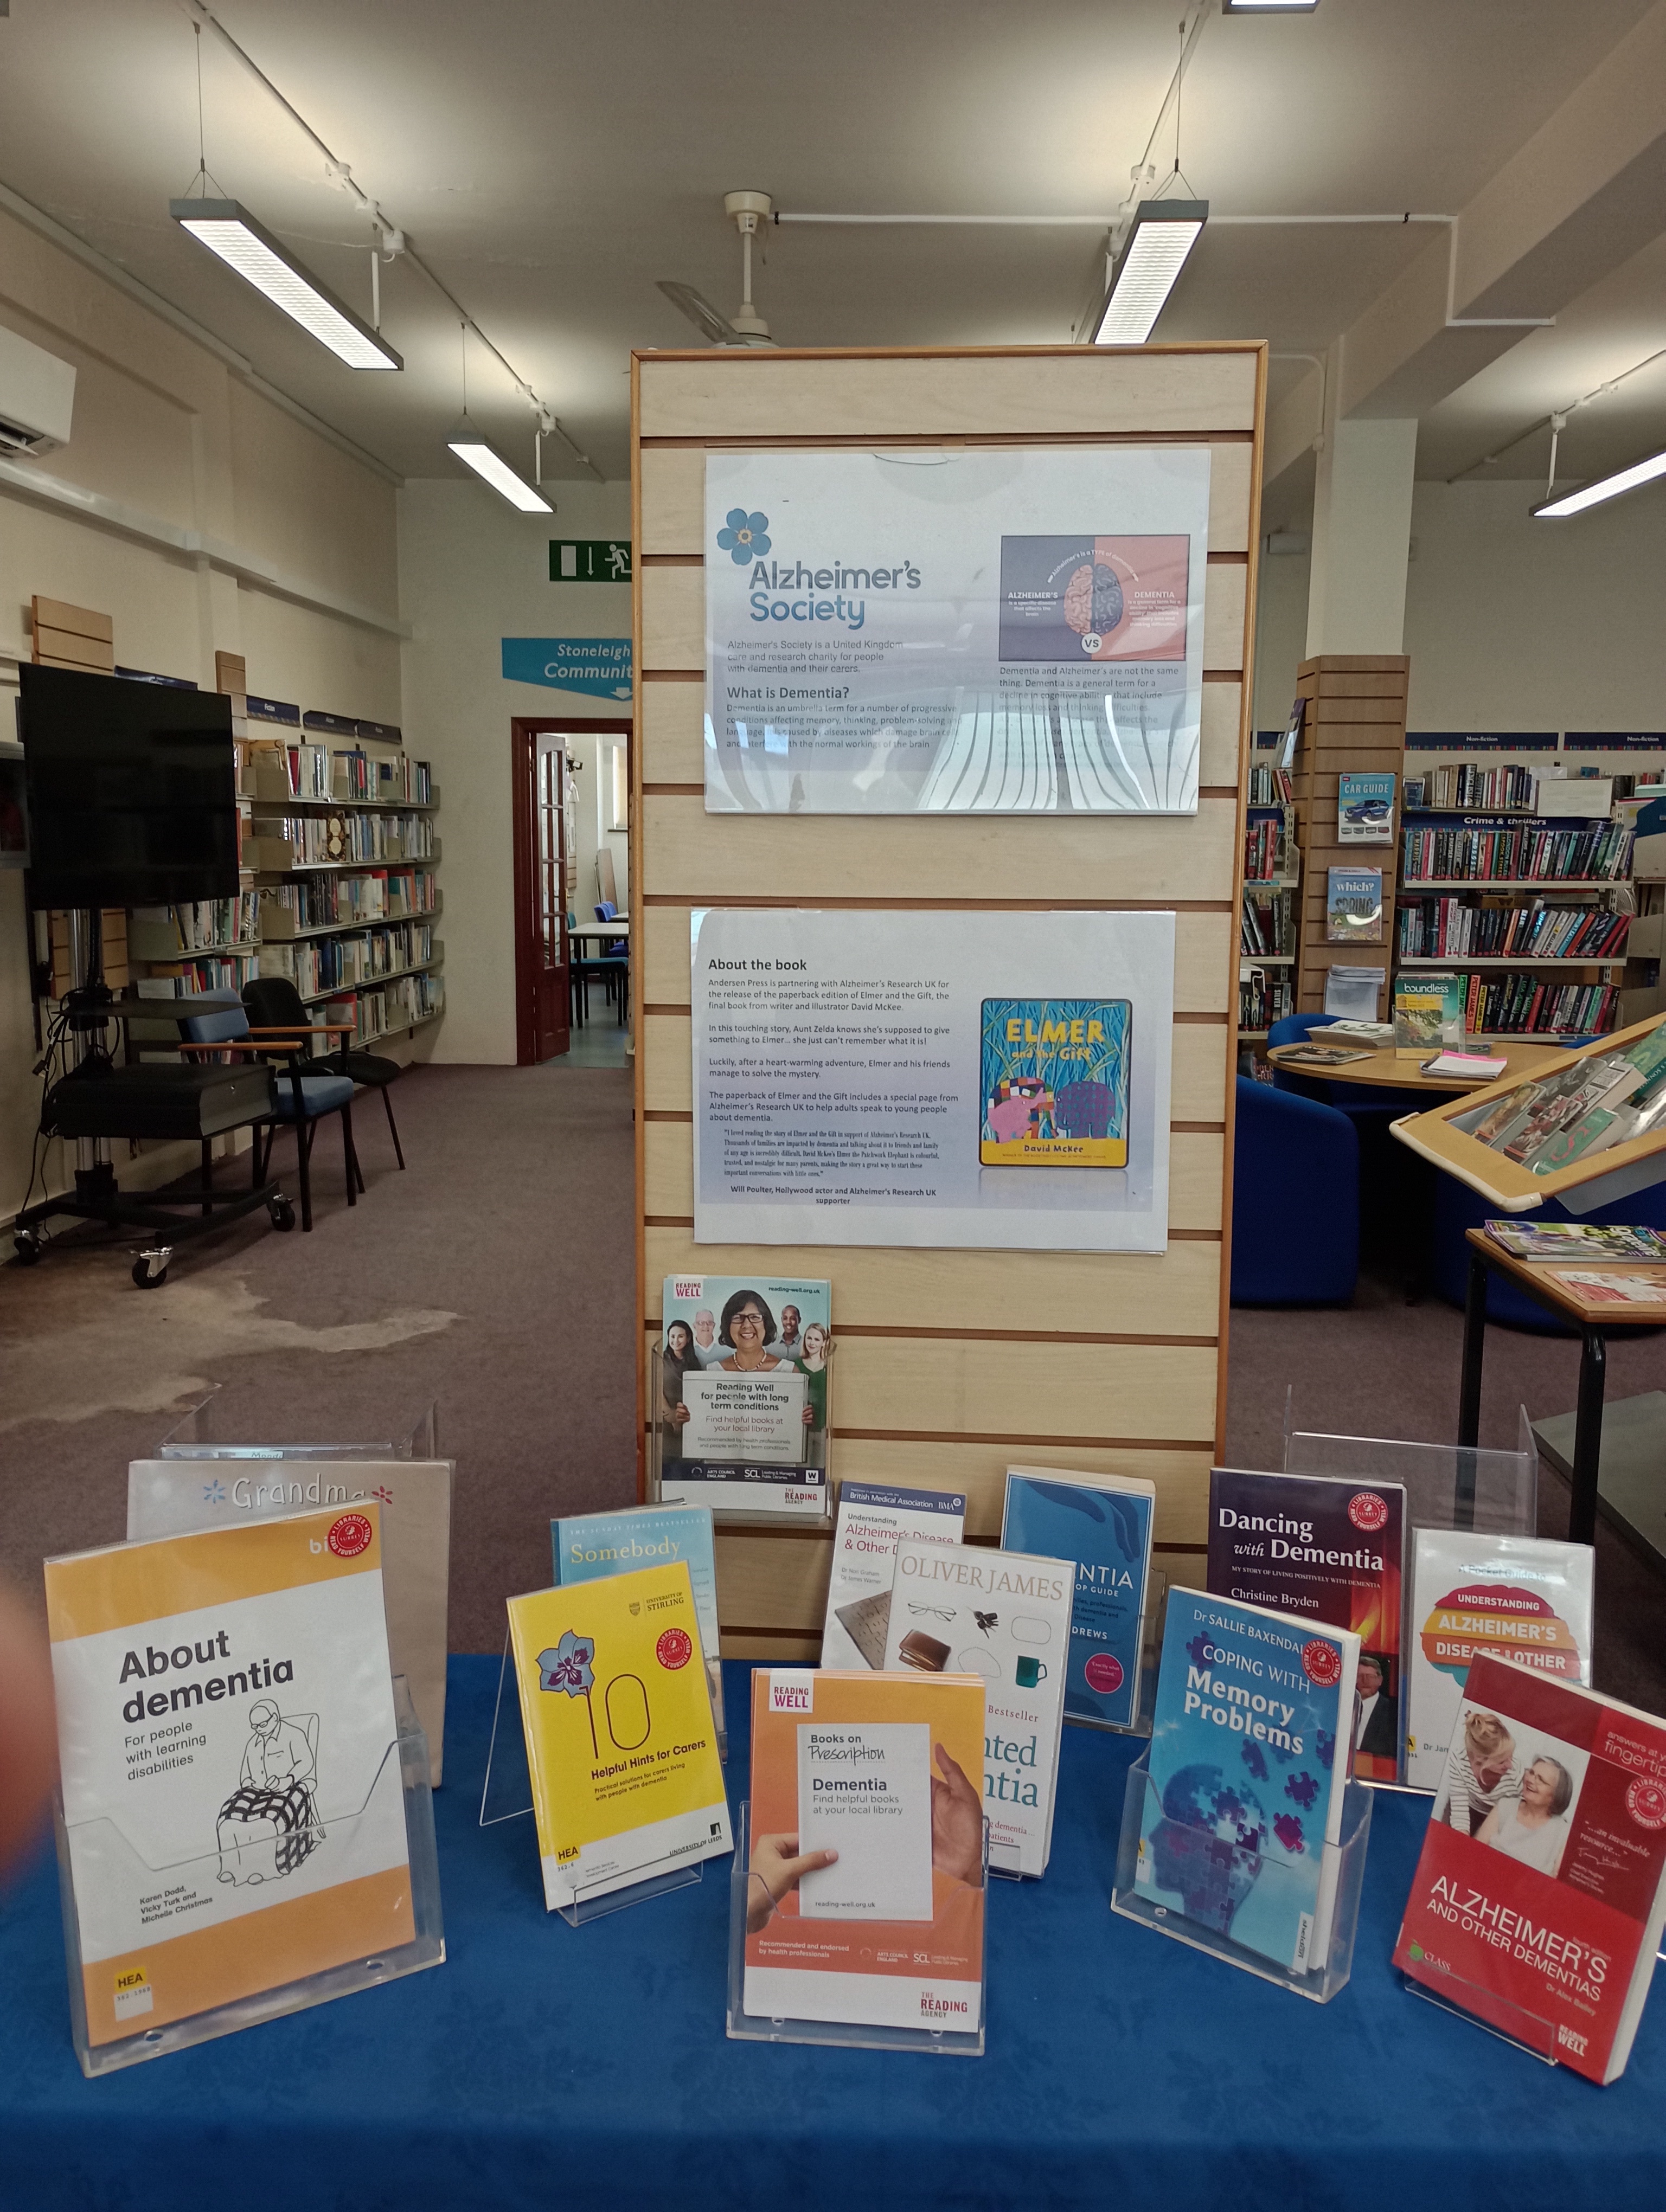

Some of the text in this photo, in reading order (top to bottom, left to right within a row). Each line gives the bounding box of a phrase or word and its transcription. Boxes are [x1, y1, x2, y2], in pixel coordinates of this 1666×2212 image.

[749, 561, 921, 590] Alzheimer's
[750, 592, 865, 630] Society
[728, 640, 778, 649] Alzheimer's
[780, 640, 812, 650] Society
[815, 640, 822, 648] is
[834, 640, 861, 648] United
[864, 640, 903, 651] Kingdom
[1085, 640, 1099, 648] VS
[558, 644, 631, 661] Stoneleigh
[749, 652, 766, 661] and
[768, 652, 806, 661] research
[809, 652, 837, 663] charity
[840, 652, 851, 661] for
[854, 654, 883, 662] people
[544, 663, 632, 678] Communit
[727, 687, 849, 698] What is Dementia?
[1345, 784, 1388, 794] CAR GUIDE
[1336, 882, 1375, 892] which?
[708, 959, 807, 971] About the book
[1404, 983, 1449, 993] boundless
[1007, 1019, 1105, 1044] ELMER
[1011, 1047, 1091, 1060] and the Gift
[1024, 1144, 1050, 1153] David
[676, 1289, 701, 1297] WELL
[716, 1383, 774, 1392] Reading Well
[716, 1393, 746, 1402] people
[770, 1394, 789, 1403] long
[734, 1403, 779, 1411] conditions
[724, 1416, 749, 1425] helpful
[752, 1425, 775, 1434] library
[744, 1469, 760, 1478] SCL
[785, 1491, 817, 1501] READING
[850, 1492, 870, 1501] British
[871, 1494, 896, 1504] Medical
[898, 1497, 933, 1509] Association
[334, 1516, 366, 1530] LIBRARIES
[848, 1513, 897, 1526] Understanding
[1219, 1508, 1313, 1543] Dancing
[337, 1542, 364, 1556] YOURSELF
[571, 1536, 680, 1563] Somebody
[856, 1540, 890, 1554] Other
[1234, 1539, 1384, 1571] with Dementia
[901, 1556, 1063, 1600] OLIVER JAMES
[1091, 1586, 1119, 1598] GUIDE
[1231, 1588, 1319, 1608] Christine Bryden
[647, 1597, 684, 1612] STIRLING
[1458, 1594, 1540, 1611] UNDERSTANDING
[1209, 1615, 1245, 1635] SALLIE
[1439, 1615, 1556, 1641] ALZHEIMER'S
[119, 1630, 231, 1683] About
[1308, 1641, 1337, 1657] LIBRARIES
[1514, 1651, 1565, 1669] OTHER
[1202, 1645, 1310, 1694] COPING WITH
[123, 1659, 294, 1723] dementia
[774, 1687, 809, 1695] READING
[1187, 1666, 1295, 1727] Memory
[774, 1695, 809, 1708] WELL
[579, 1673, 651, 1759] 10
[988, 1705, 1039, 1722] Bestseller
[1184, 1691, 1303, 1754] Problems
[125, 1721, 193, 1748] For people
[811, 1734, 844, 1743] Books
[1607, 1732, 1646, 1752] answers
[126, 1733, 207, 1764] with learning
[808, 1745, 885, 1766] Prescription
[127, 1754, 194, 1780] disabilities
[591, 1740, 706, 1780] Helpful Hints for Carers
[608, 1775, 667, 1799] people with dementia
[813, 1778, 887, 1791] Dementia
[813, 1795, 833, 1803] Find
[836, 1795, 868, 1805] helpful
[825, 1808, 846, 1816] your
[849, 1806, 871, 1814] local
[873, 1806, 903, 1816] library
[708, 1835, 722, 1843] LEEDS
[558, 1847, 578, 1860] HEA
[139, 1886, 187, 1904] Karen Dodd,
[140, 1892, 196, 1915] Vicky Turk and
[142, 1897, 213, 1924] Michelle Christmas
[1431, 1875, 1607, 1983] ALZHEIMER'S
[759, 1940, 806, 1949] Recommended
[1426, 1899, 1458, 1923] AND
[1461, 1917, 1511, 1952] OTHER
[1514, 1944, 1601, 2001] DEMENTIAS
[789, 1950, 830, 1958] professionals
[913, 1953, 930, 1964] SCL
[1424, 1951, 1451, 1971] CLASS
[117, 1972, 144, 1989] HEA
[921, 1999, 967, 2012] READING
[1558, 2030, 1585, 2056] WELL
